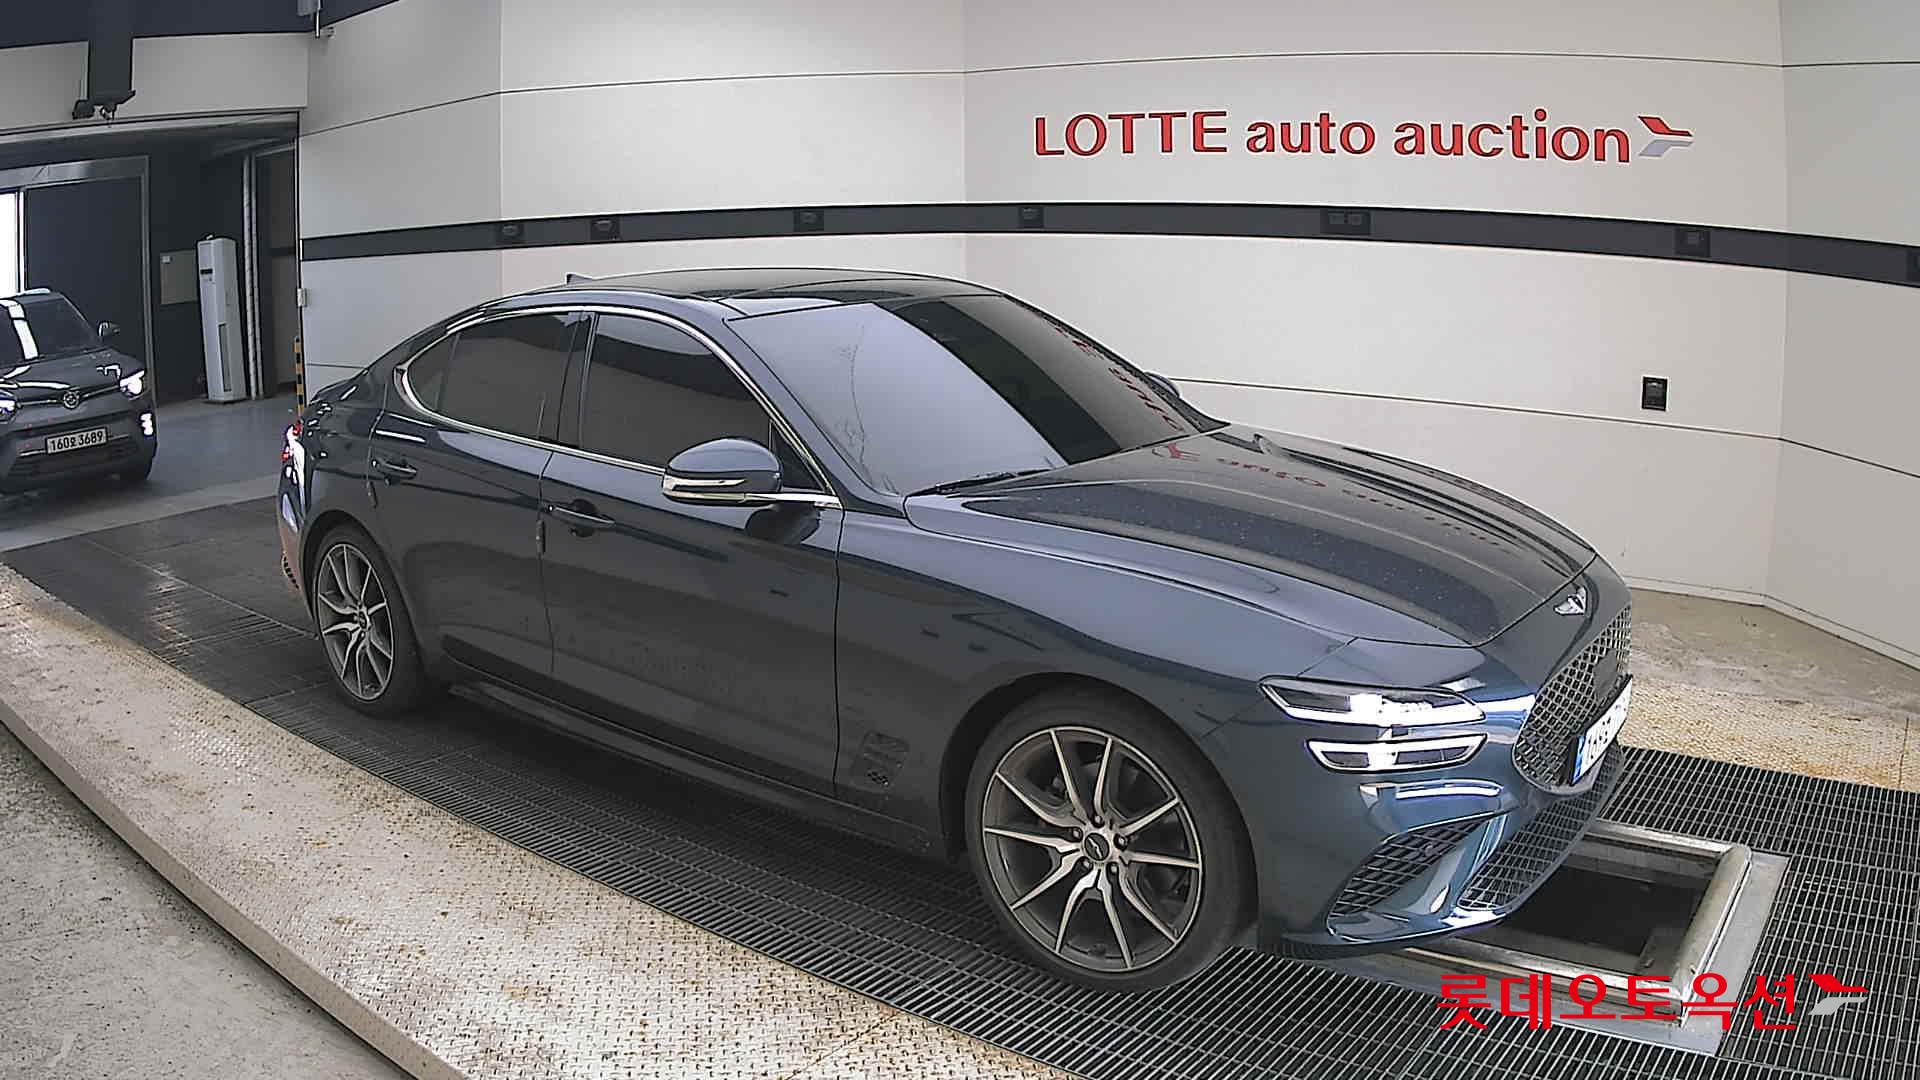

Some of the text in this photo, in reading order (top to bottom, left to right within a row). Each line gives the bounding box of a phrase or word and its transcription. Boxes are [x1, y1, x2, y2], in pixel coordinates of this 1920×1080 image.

[1035, 108, 1630, 162] LOTTE auto auction
